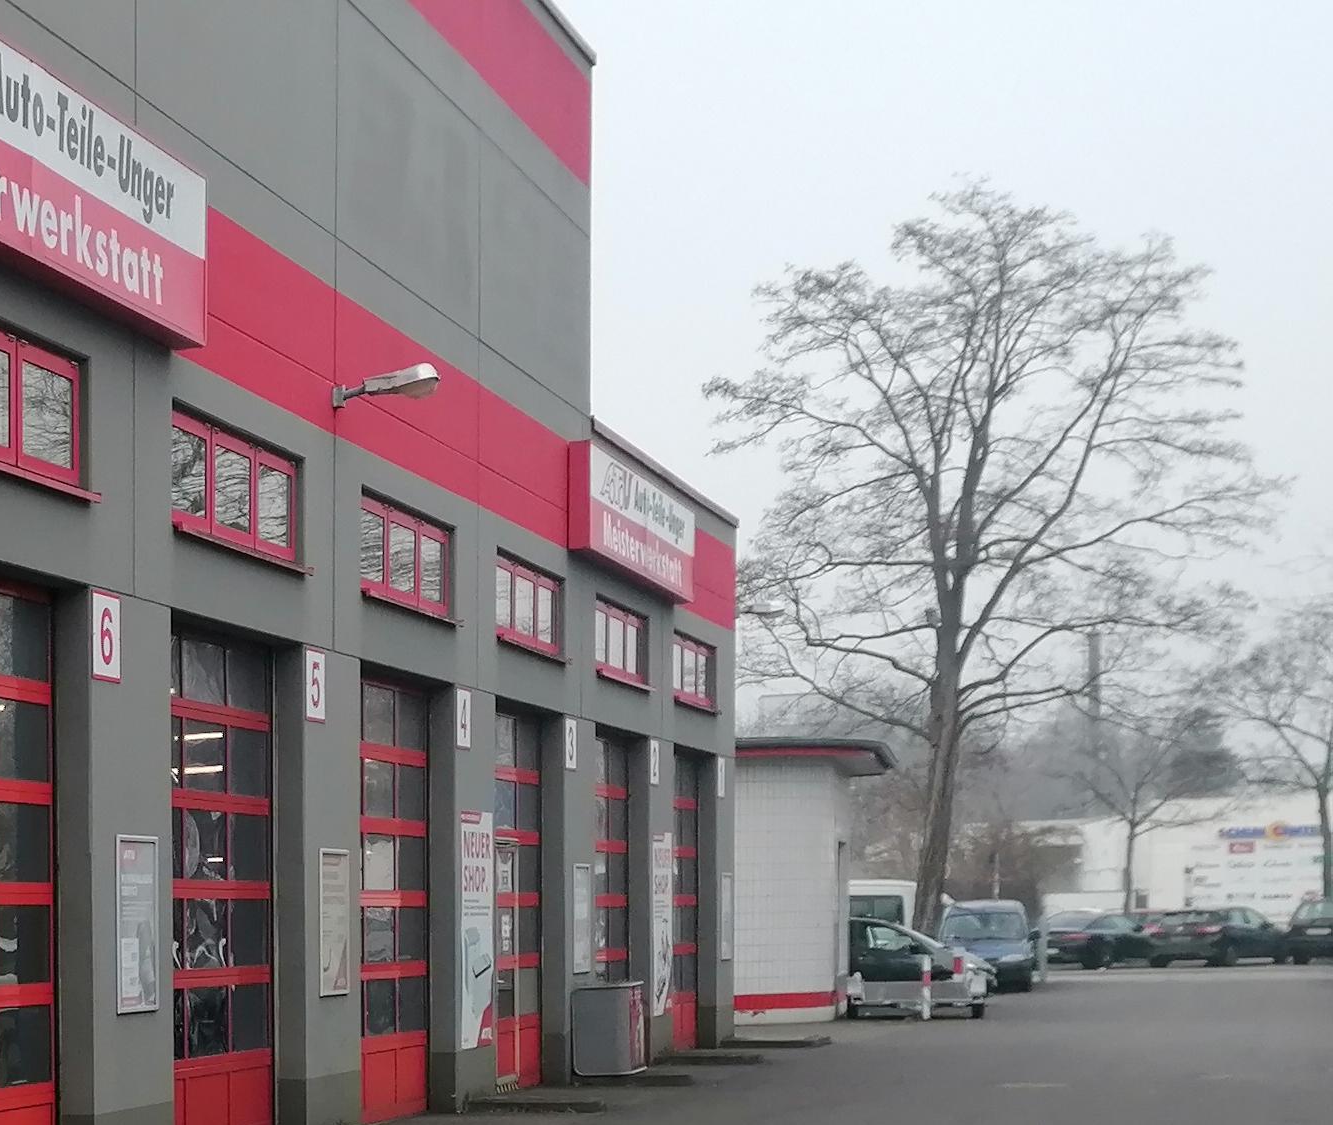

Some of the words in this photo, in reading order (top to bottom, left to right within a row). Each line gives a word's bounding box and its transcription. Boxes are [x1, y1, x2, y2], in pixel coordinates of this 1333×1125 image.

[602, 510, 683, 588] Meisterwerkstatt
[100, 607, 114, 666] 6
[311, 661, 320, 709] 5
[460, 699, 468, 738] 4
[567, 726, 575, 762] 3
[652, 747, 658, 777] 2
[463, 830, 490, 860] NEUER
[463, 864, 488, 892] SHOP.
